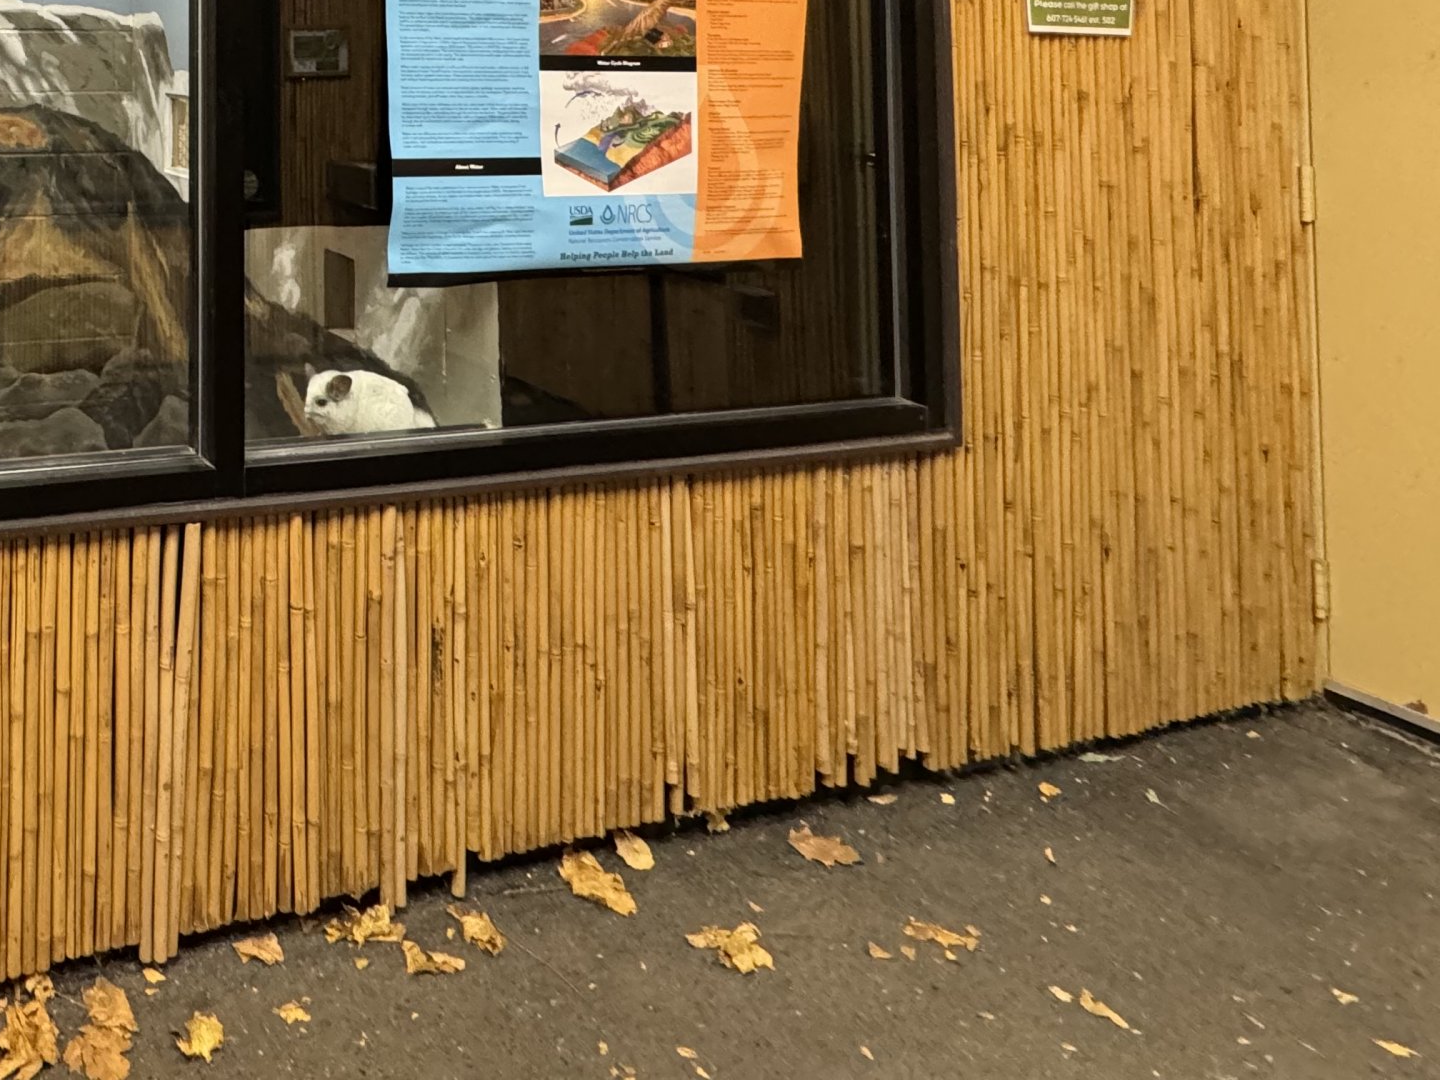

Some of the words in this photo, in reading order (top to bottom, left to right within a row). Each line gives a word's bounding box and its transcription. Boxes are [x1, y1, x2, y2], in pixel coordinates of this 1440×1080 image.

[1034, 0, 1062, 9] Please
[1076, 1, 1087, 10] the
[1087, 2, 1100, 11] gift
[1100, 3, 1118, 11] shop
[1119, 3, 1128, 11] at
[569, 206, 594, 215] USDA
[617, 203, 652, 223] NRCS
[560, 252, 591, 262] Helping
[593, 251, 619, 260] People
[621, 250, 639, 259] Help
[641, 249, 653, 257] the
[654, 248, 674, 256] Land
